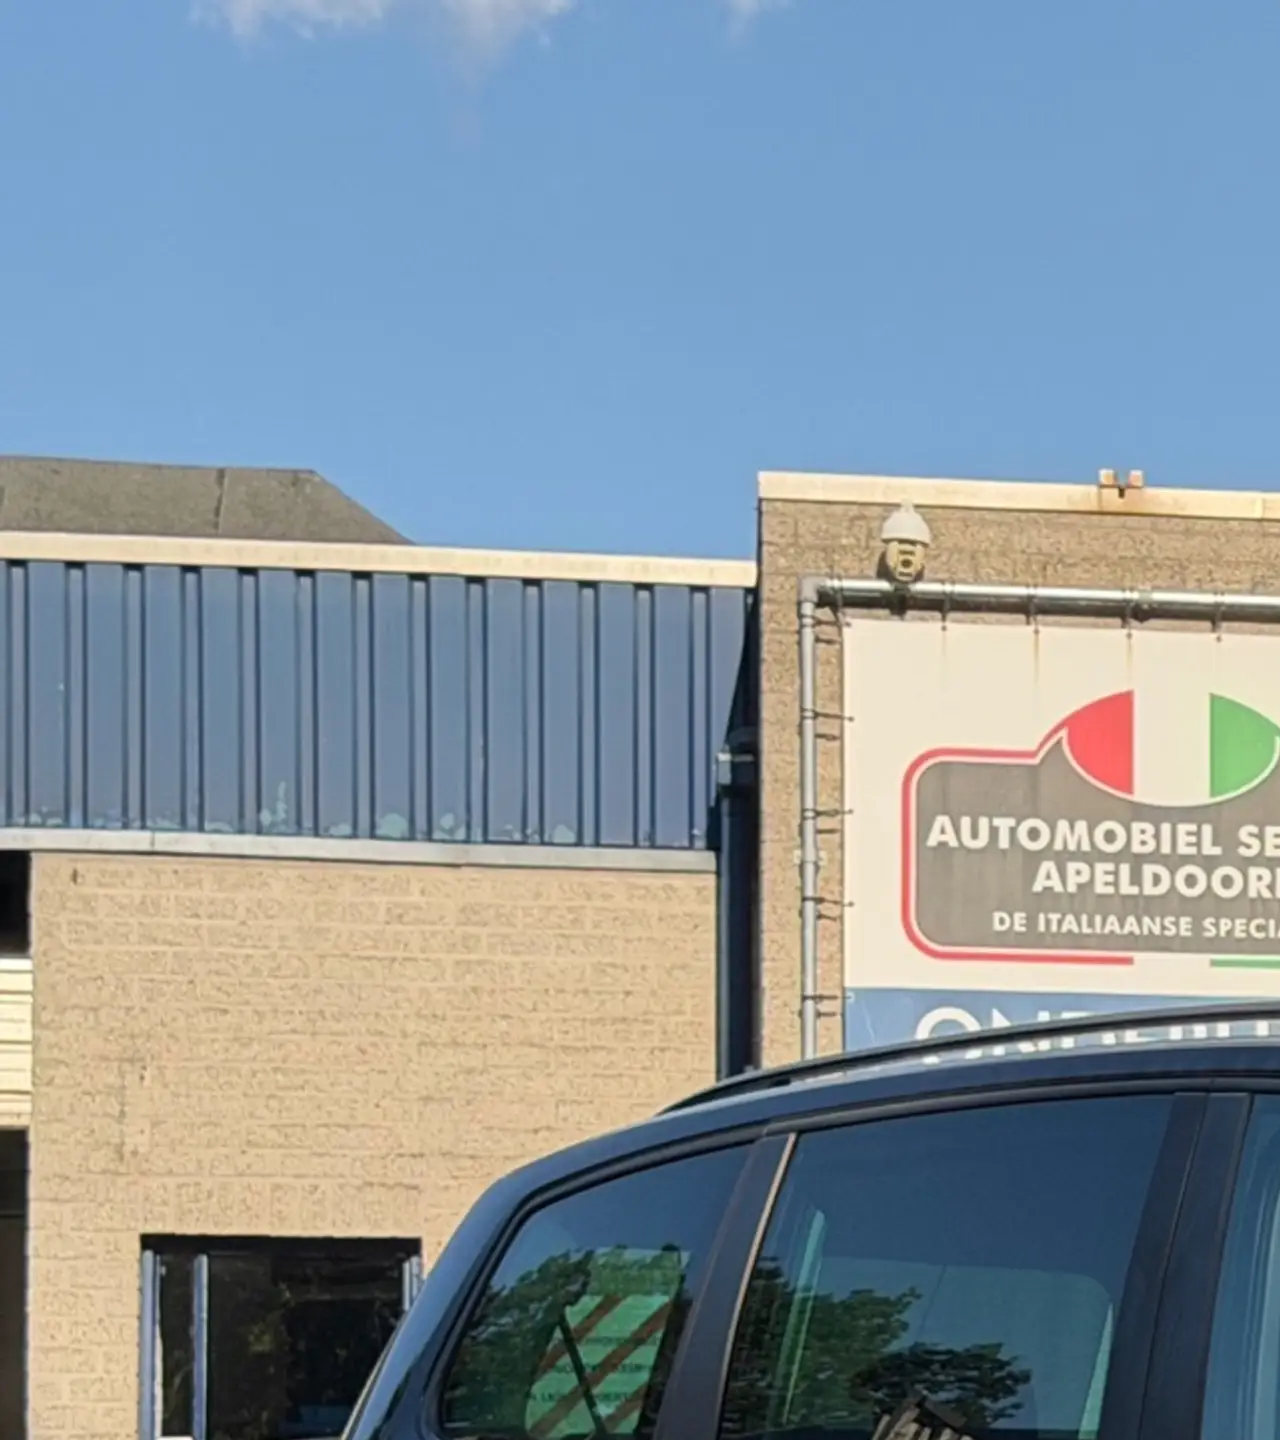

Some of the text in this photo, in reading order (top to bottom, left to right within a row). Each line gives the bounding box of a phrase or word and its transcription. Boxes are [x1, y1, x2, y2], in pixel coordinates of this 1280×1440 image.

[926, 814, 1223, 856] AUTOMOBIEL
[992, 911, 1027, 932] DE
[1037, 912, 1193, 937] ITALIAANSE
